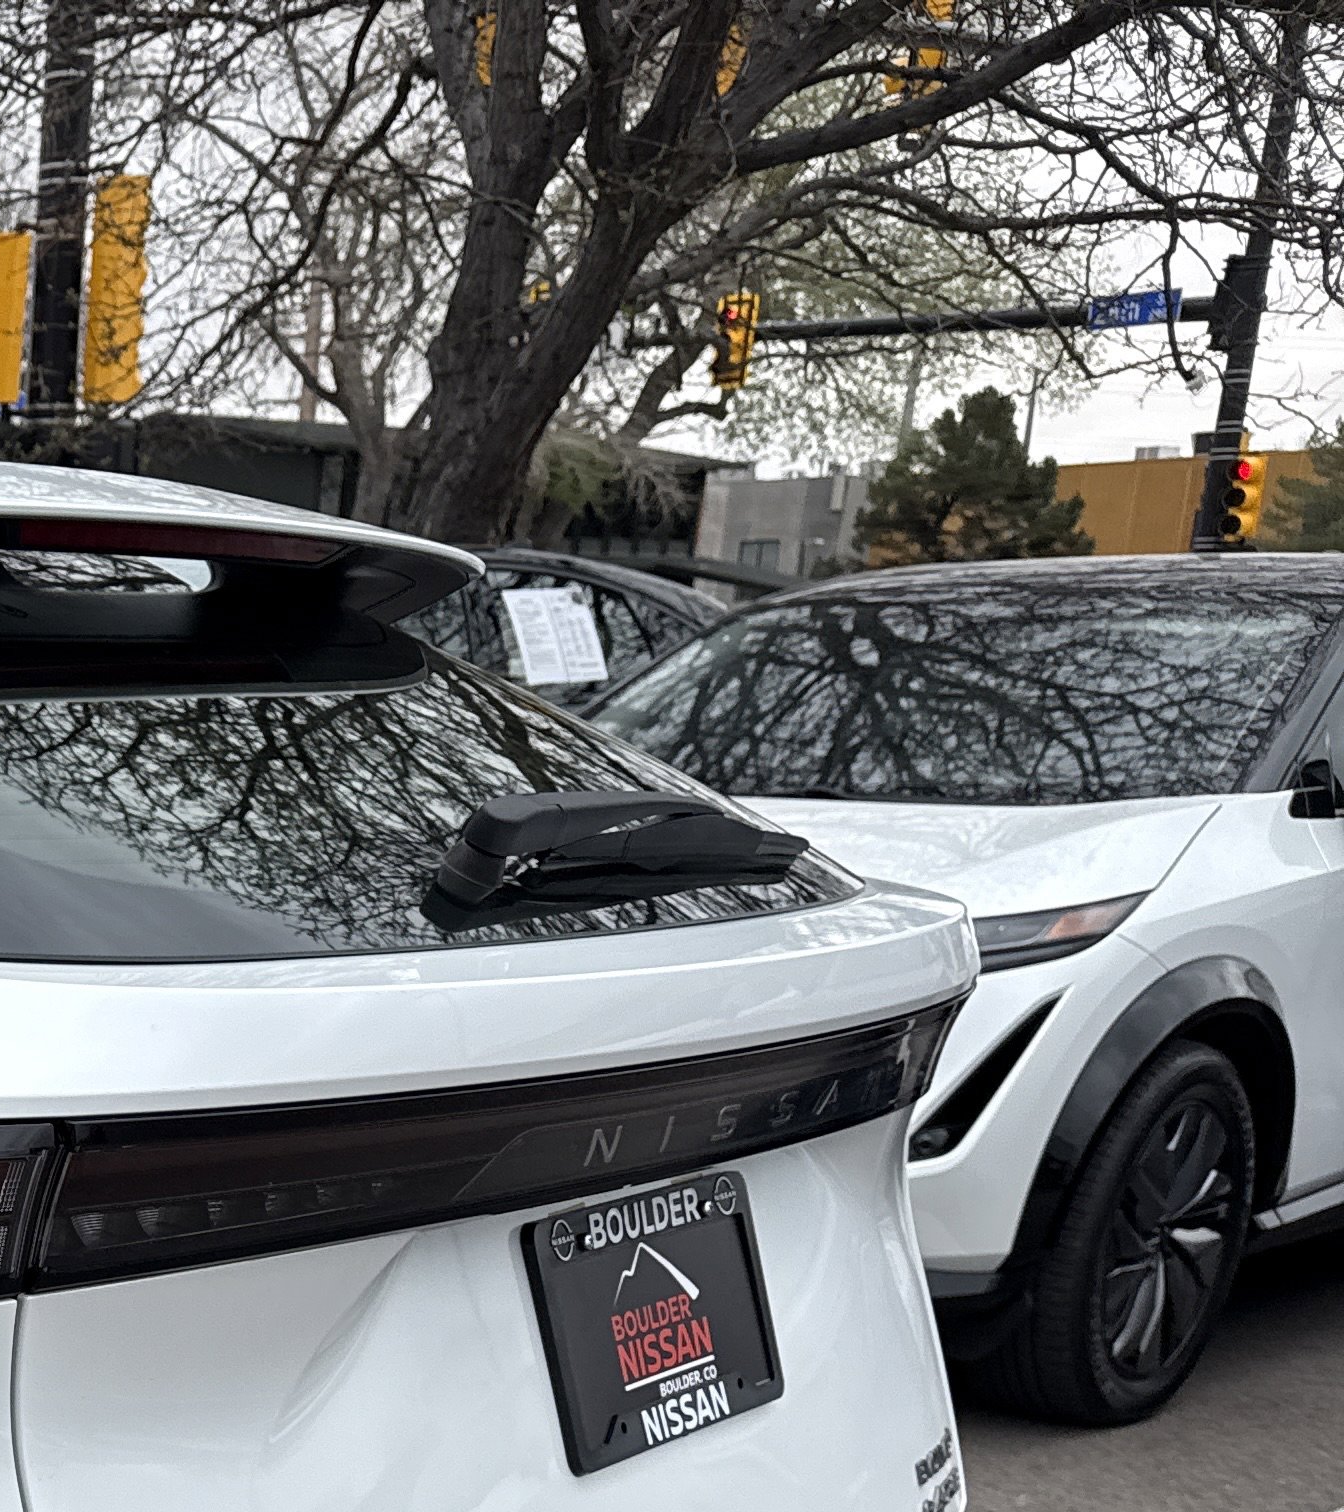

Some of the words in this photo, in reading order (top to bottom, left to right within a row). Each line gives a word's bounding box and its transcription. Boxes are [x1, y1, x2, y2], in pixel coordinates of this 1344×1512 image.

[588, 1186, 702, 1250] BOULDER
[714, 1190, 737, 1201] NISSAN
[551, 1233, 575, 1246] NISSAN
[611, 1294, 693, 1342] BOULDER
[616, 1316, 714, 1384] NISSAN
[703, 1364, 718, 1381] CO
[641, 1380, 730, 1446] NISSAN
